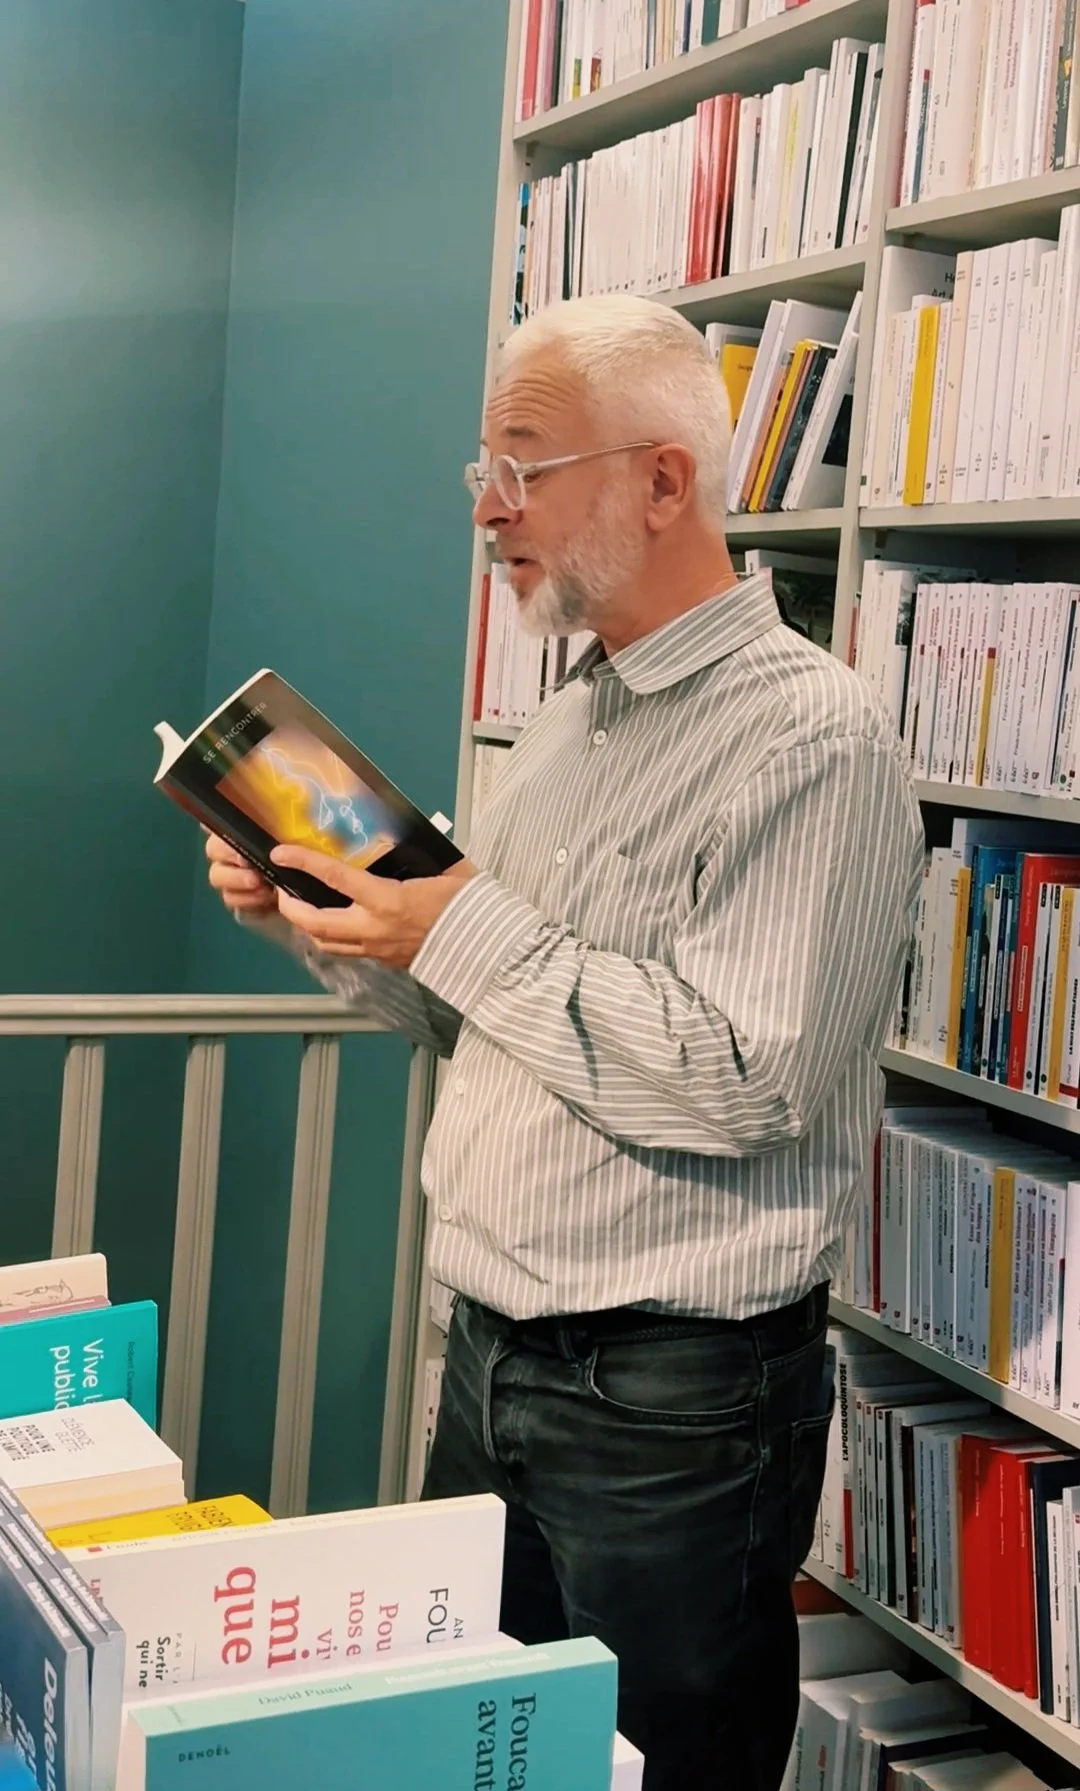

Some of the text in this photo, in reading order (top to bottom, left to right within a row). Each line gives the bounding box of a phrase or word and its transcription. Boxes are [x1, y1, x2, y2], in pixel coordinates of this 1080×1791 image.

[203, 702, 269, 764] SE RENCONTRER
[82, 1338, 104, 1389] Vive
[214, 1566, 257, 1665] que
[267, 1595, 309, 1669] mi
[347, 1591, 365, 1639] nos
[376, 1603, 399, 1652] Pou
[426, 1588, 449, 1644] FOU
[453, 1617, 464, 1639] AN
[136, 1640, 153, 1689] qui ne
[155, 1636, 171, 1682] Sortir
[257, 1690, 302, 1707] David
[178, 1746, 232, 1763] DENOËL
[473, 1700, 497, 1791] avant
[506, 1693, 536, 1791] Fouca
